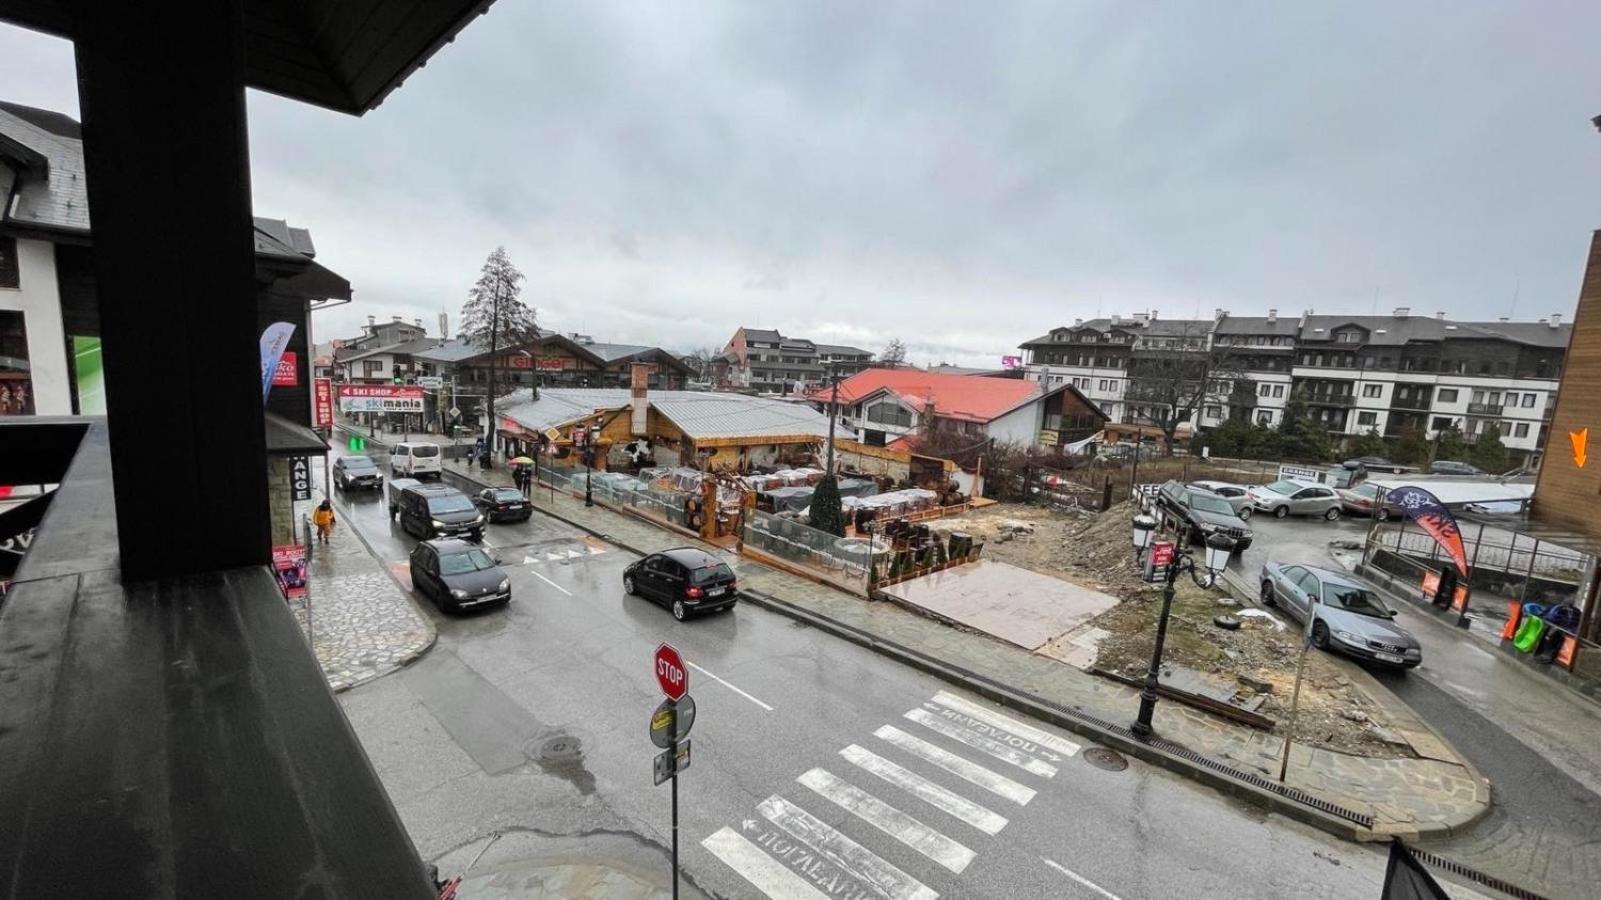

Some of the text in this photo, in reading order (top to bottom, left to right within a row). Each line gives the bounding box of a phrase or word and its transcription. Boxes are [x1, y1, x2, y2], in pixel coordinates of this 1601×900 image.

[352, 388, 368, 396] SKI
[369, 388, 392, 396] SHOP
[366, 398, 421, 408] skimania
[293, 457, 307, 500] ANGE
[658, 658, 683, 686] STOP
